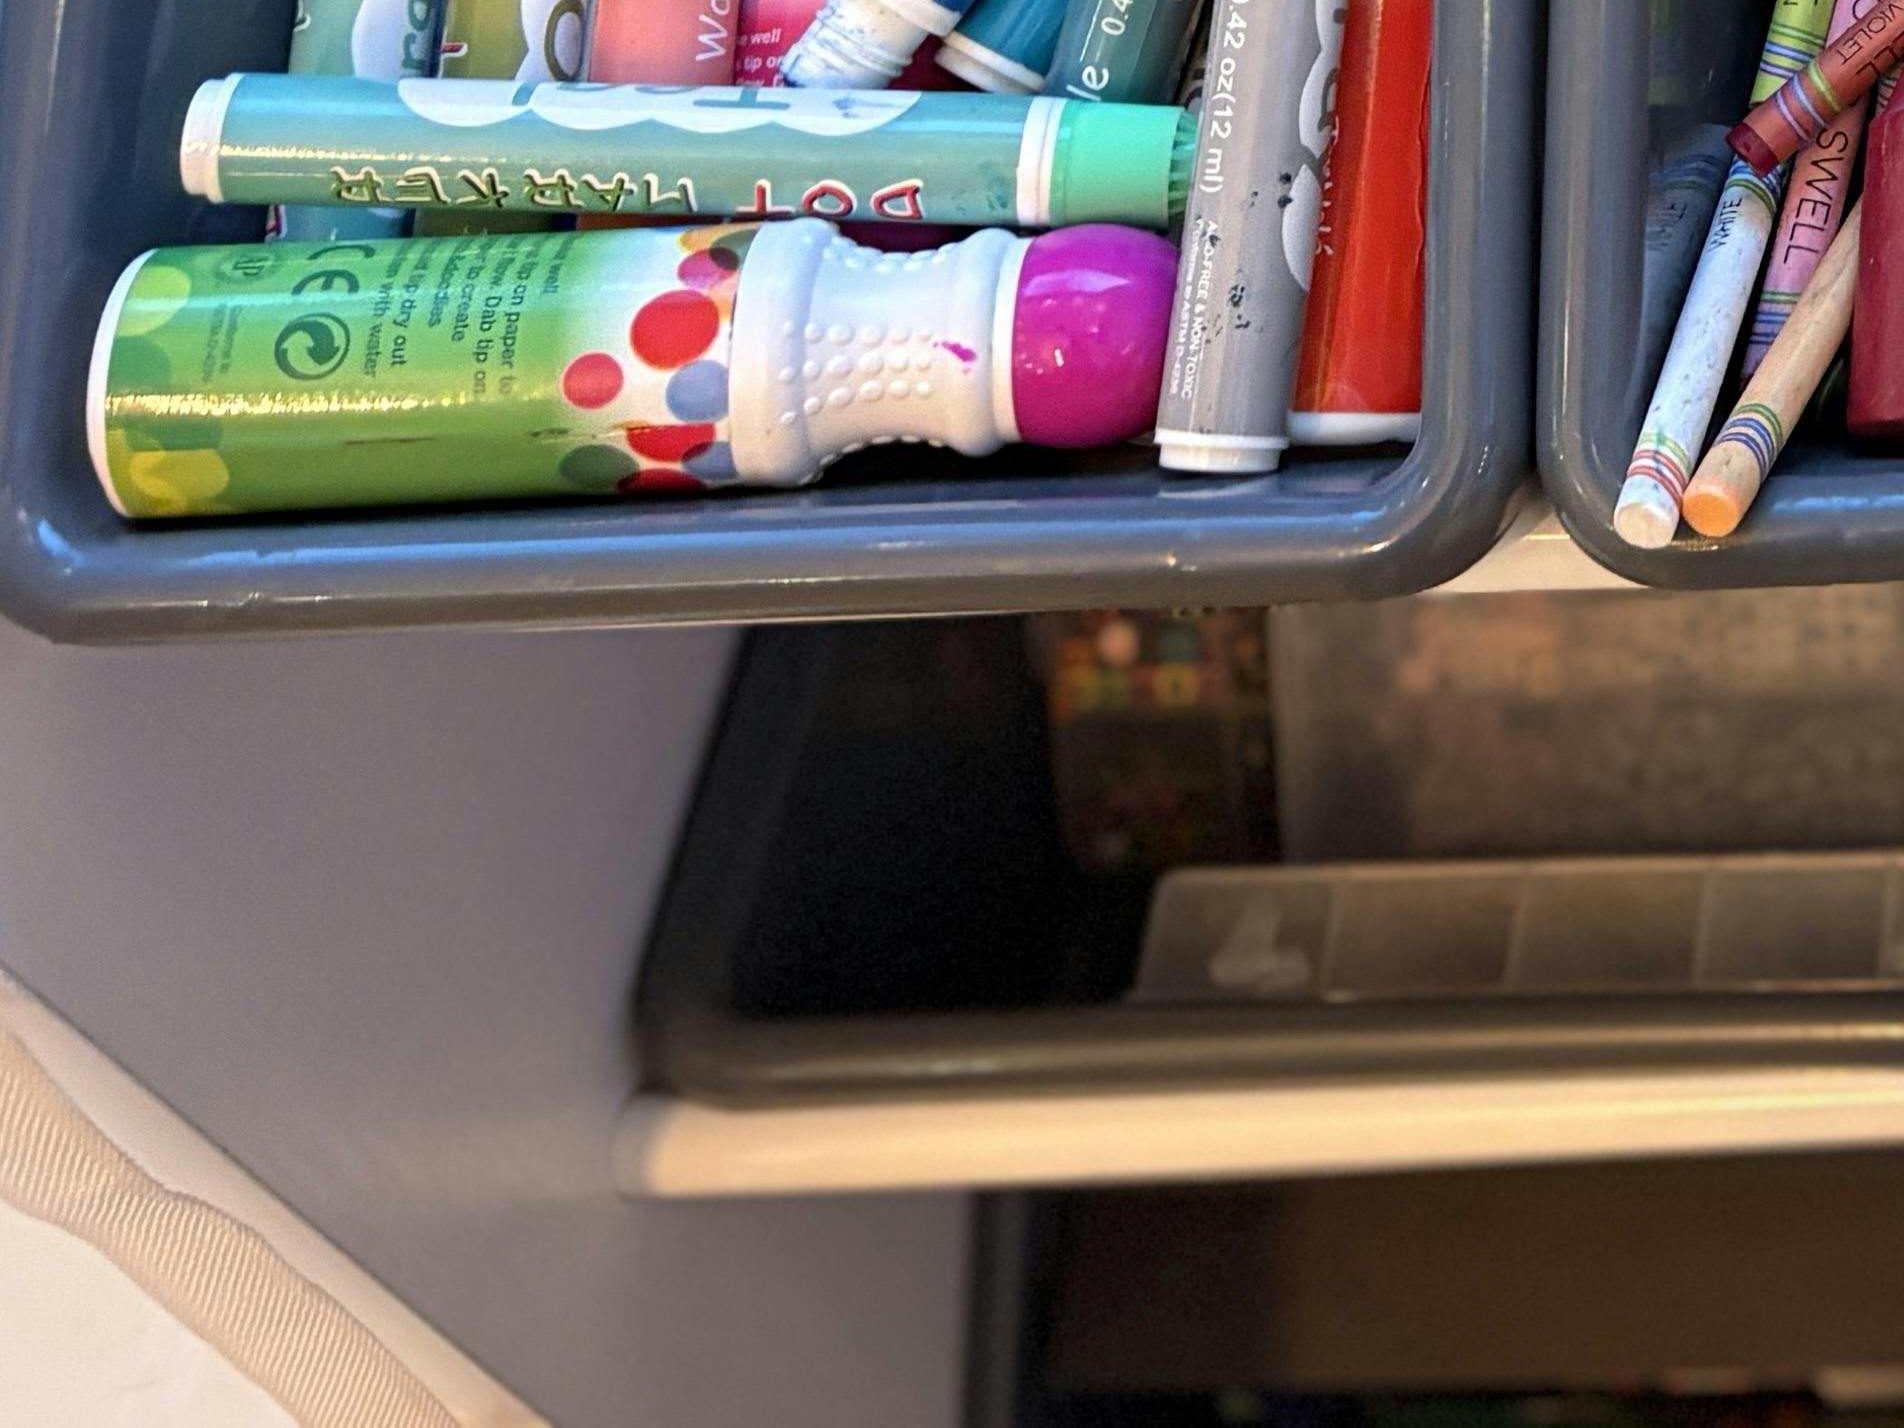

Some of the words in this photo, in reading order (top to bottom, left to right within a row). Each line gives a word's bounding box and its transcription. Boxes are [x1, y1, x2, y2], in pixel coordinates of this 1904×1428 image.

[1207, 53, 1239, 142] oz(12
[331, 166, 698, 213] MARKER
[1198, 140, 1225, 194] ml)
[736, 177, 924, 221] DOT
[1708, 194, 1742, 249] WHITE
[1784, 129, 1850, 265] SWELL
[391, 297, 417, 329] dry
[479, 294, 503, 334] Dab
[390, 334, 408, 368] out
[500, 310, 521, 370] paper
